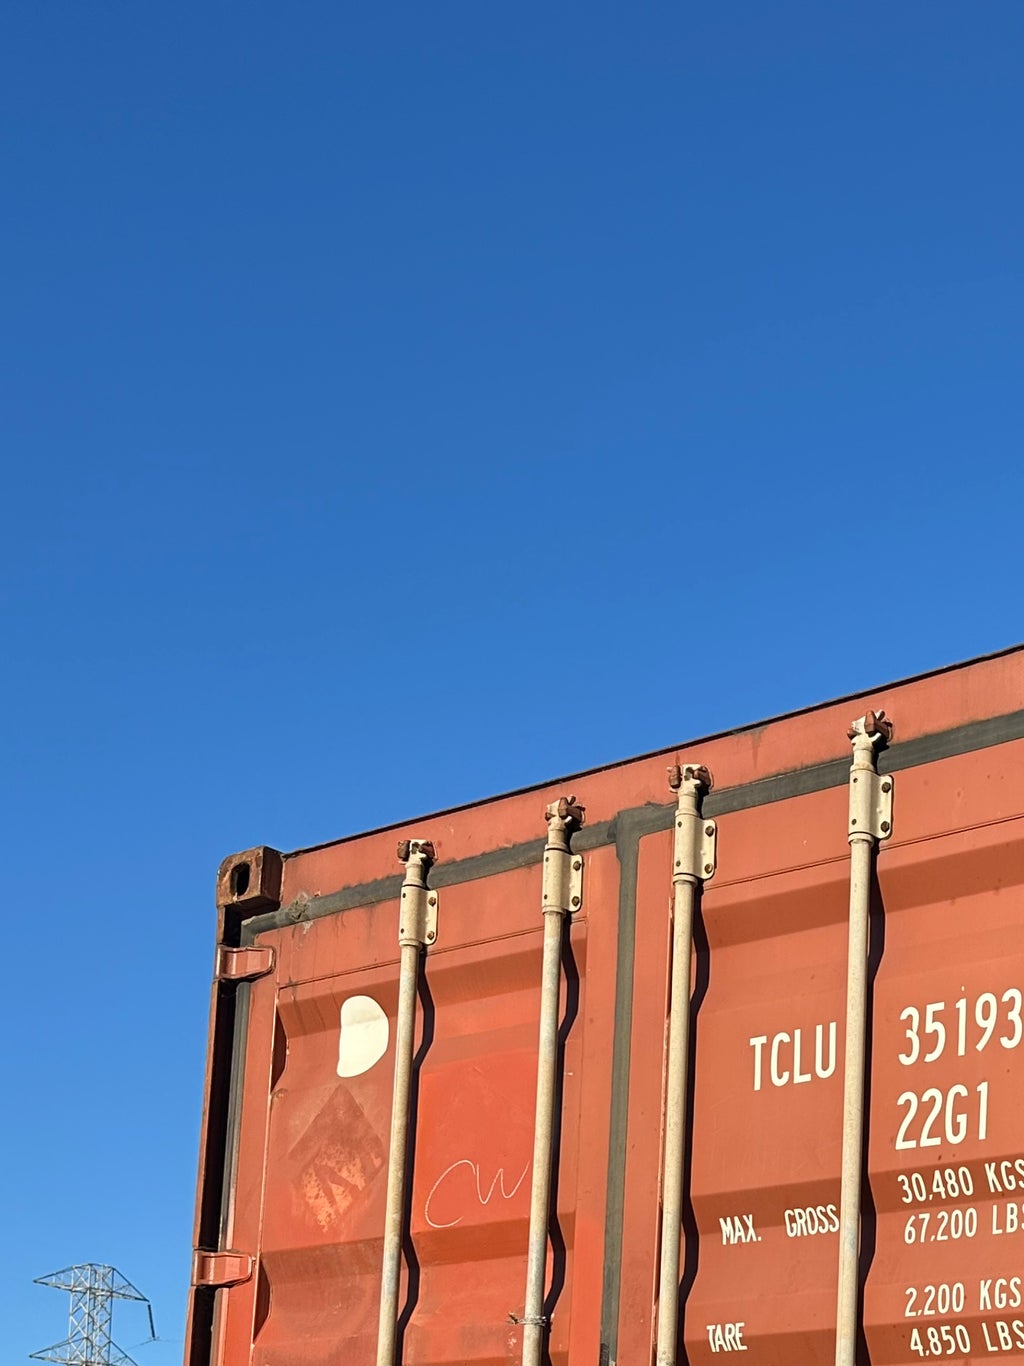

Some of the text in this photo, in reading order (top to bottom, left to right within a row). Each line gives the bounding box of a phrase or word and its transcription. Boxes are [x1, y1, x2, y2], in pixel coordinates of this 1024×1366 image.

[750, 1021, 837, 1091] TCLU
[895, 1081, 989, 1150] 22G1
[897, 1166, 974, 1204] 30,480
[719, 1204, 840, 1245] MAX. GROSS
[904, 1207, 978, 1244] 67,200
[904, 1282, 965, 1317] 2,200
[706, 1321, 748, 1353] TARE
[910, 1324, 971, 1357] 4,850
